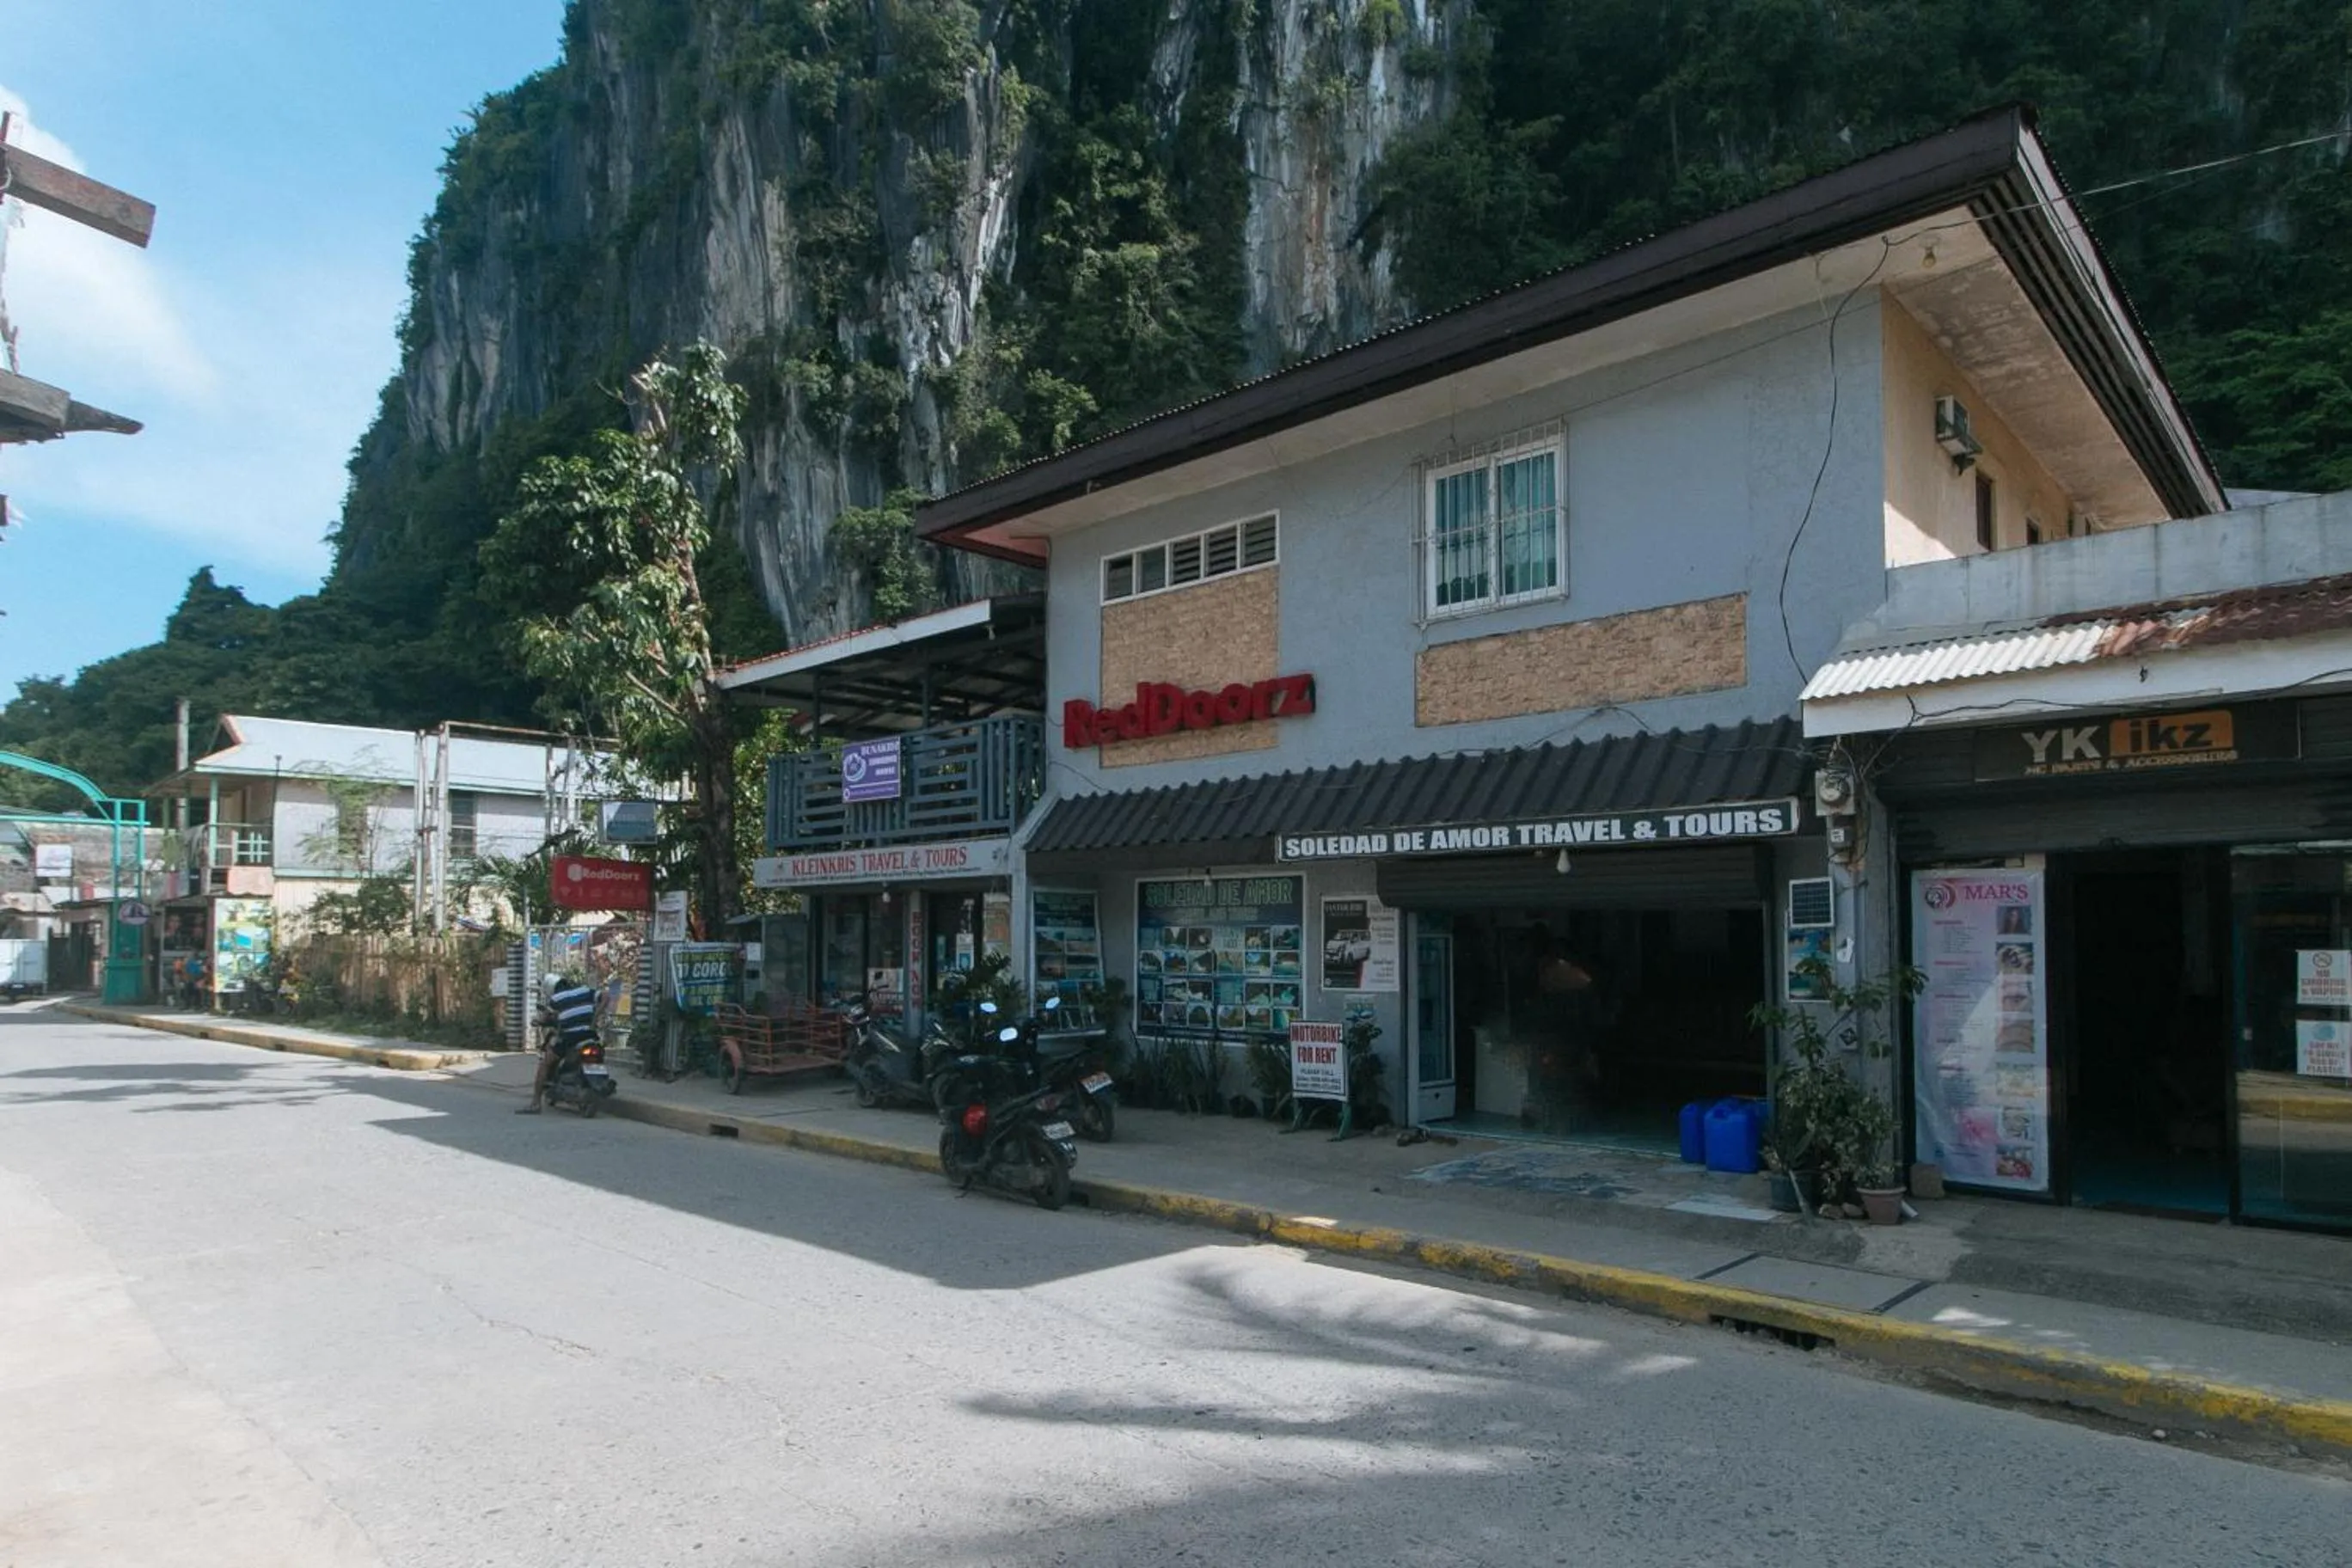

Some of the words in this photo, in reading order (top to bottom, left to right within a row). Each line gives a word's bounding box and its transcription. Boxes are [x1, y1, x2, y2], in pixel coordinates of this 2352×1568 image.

[1063, 674, 1315, 748] RedDoorz
[2021, 726, 2102, 763] YK
[1286, 832, 1387, 858] SOLEDAD
[1393, 830, 1425, 852] DE
[1430, 824, 1510, 849] AMOR
[1516, 818, 1626, 846] TRAVEL
[1632, 820, 1657, 840] &
[1663, 808, 1783, 837] TOURS
[861, 850, 910, 872] TRAVEL
[910, 849, 920, 868] &
[925, 846, 968, 867] TOURS
[1964, 883, 2030, 901] MAR'S
[1291, 1025, 1341, 1043] MOTORBIKE
[1298, 1046, 1313, 1063] FOR
[1315, 1047, 1337, 1064] RENT
